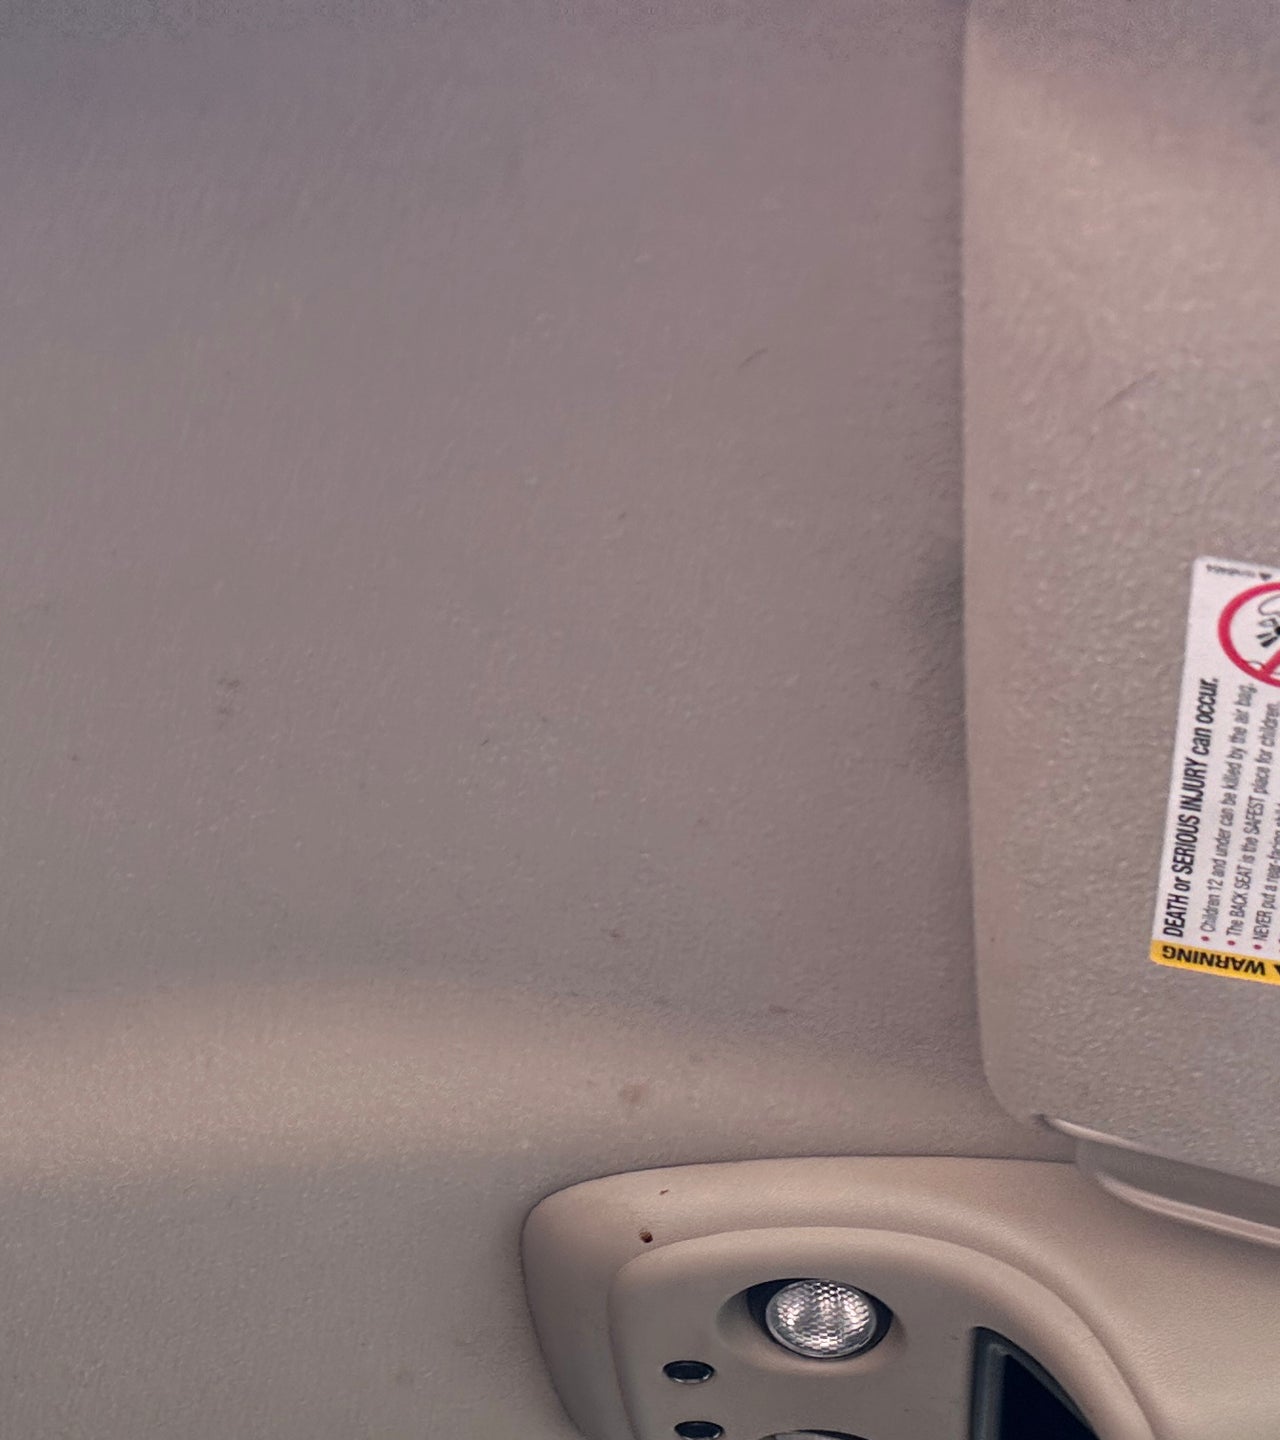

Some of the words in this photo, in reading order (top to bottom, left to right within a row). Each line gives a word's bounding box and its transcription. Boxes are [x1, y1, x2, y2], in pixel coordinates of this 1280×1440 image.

[1194, 675, 1219, 724] occur.
[1231, 707, 1250, 724] air
[1191, 725, 1212, 756] can
[1228, 725, 1248, 744] the
[1226, 745, 1248, 760] by
[1253, 747, 1273, 764] for
[1179, 757, 1208, 812] INJURY
[1221, 761, 1242, 790] killed
[1249, 765, 1273, 795] place
[1219, 791, 1237, 806] be
[1218, 807, 1235, 826] can
[1242, 795, 1265, 835] SAFEST
[1171, 813, 1200, 875] SERIOUS
[1212, 826, 1231, 857] under
[1239, 835, 1258, 853] the
[1208, 858, 1226, 877] and
[1238, 853, 1255, 864] is
[1173, 875, 1191, 892] or
[1206, 877, 1223, 891] 12
[1233, 864, 1253, 890] SEAT
[1263, 884, 1277, 892] a
[1229, 890, 1248, 918] BACK
[1258, 891, 1279, 909] put
[1163, 892, 1188, 937] DEATH
[1199, 892, 1221, 933] Children
[1226, 918, 1244, 937] The
[1252, 909, 1272, 941] NEVER
[1162, 944, 1266, 976] WARNING
